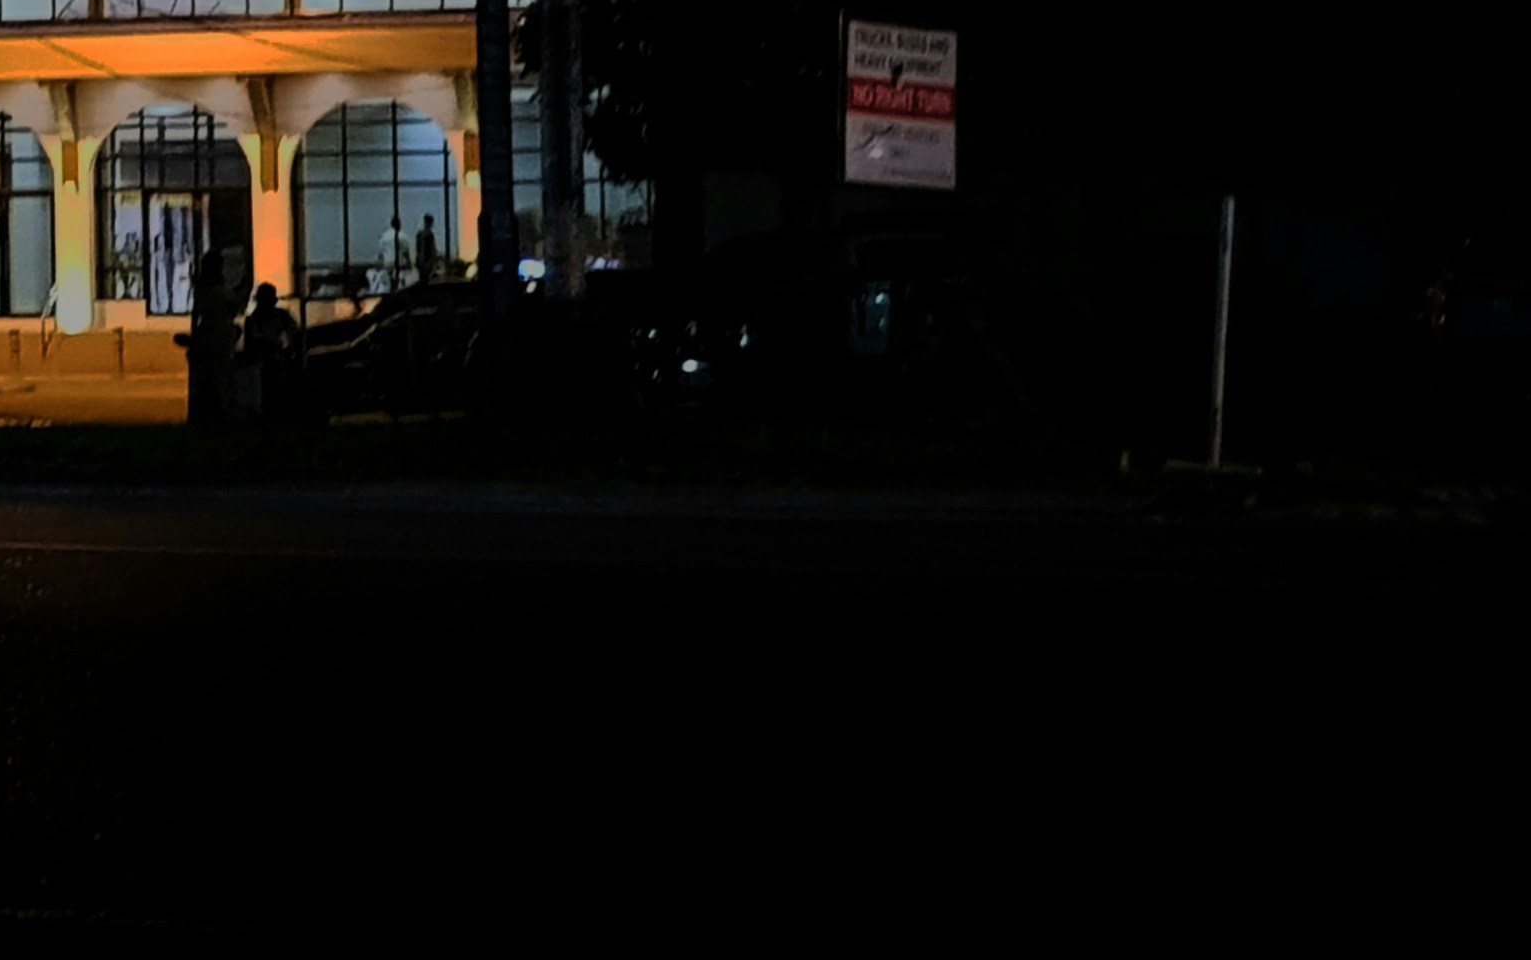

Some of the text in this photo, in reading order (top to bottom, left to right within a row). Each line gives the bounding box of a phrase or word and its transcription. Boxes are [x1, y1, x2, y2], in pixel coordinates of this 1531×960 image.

[853, 83, 952, 114] NO RIGHT TURN
